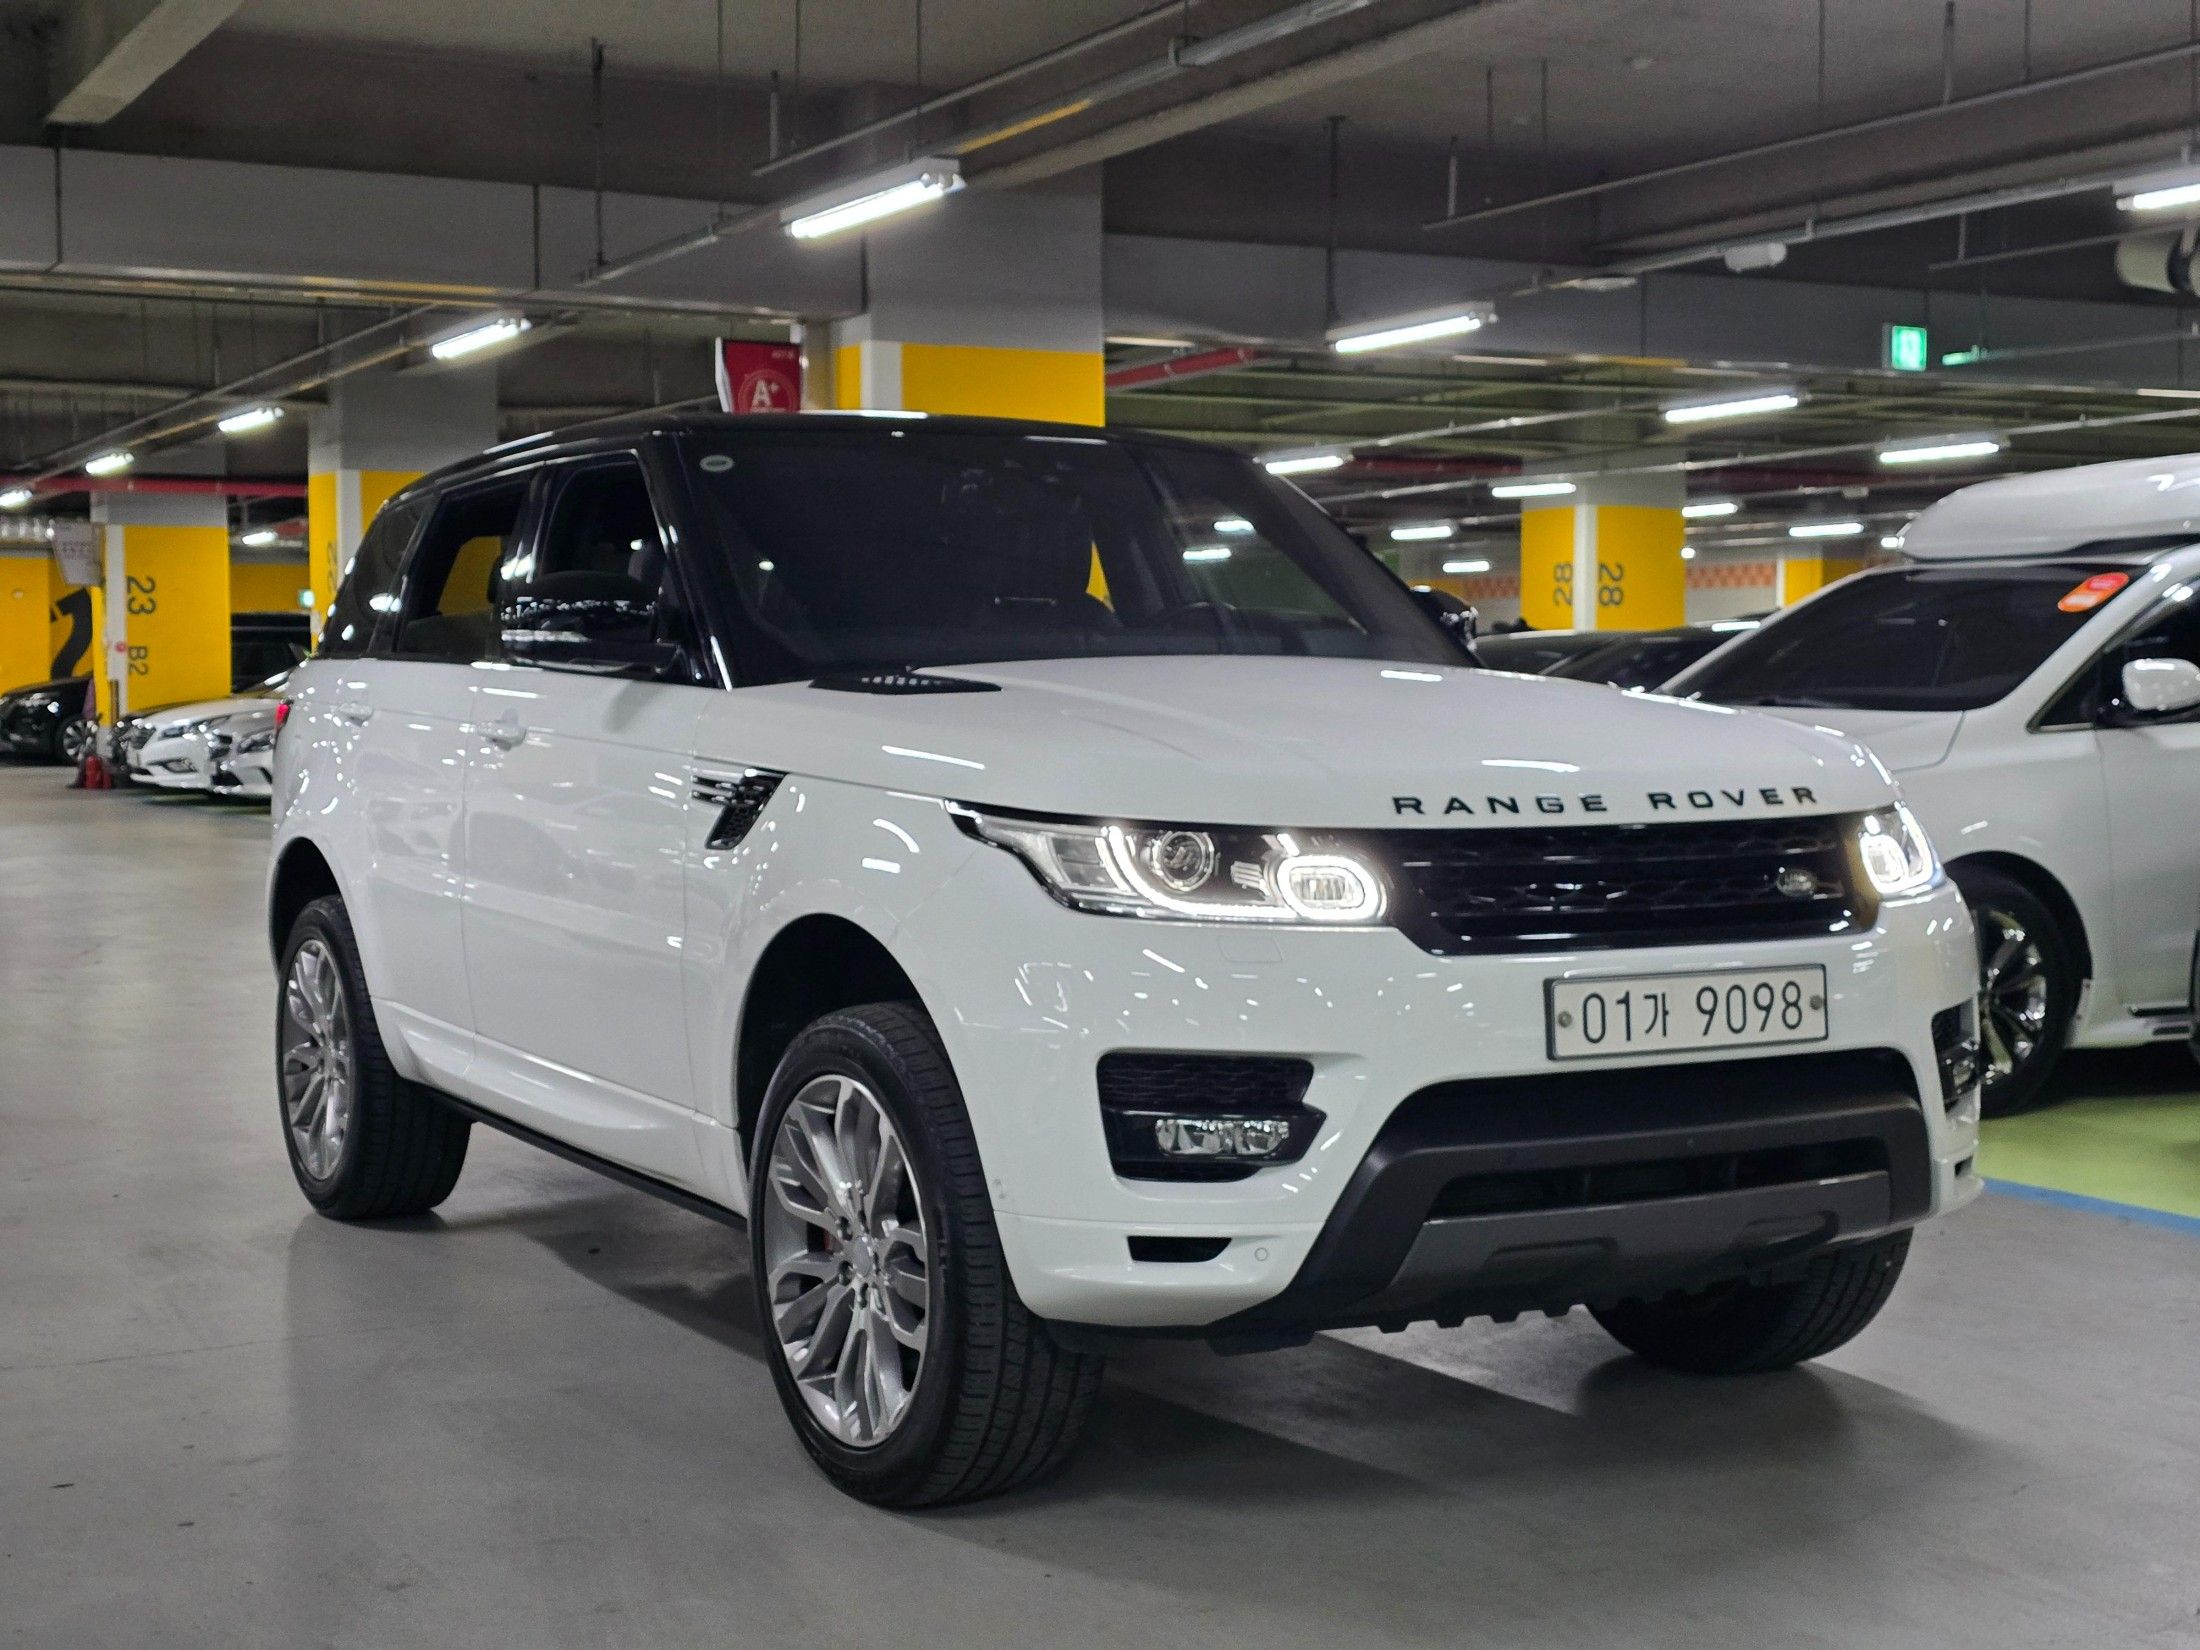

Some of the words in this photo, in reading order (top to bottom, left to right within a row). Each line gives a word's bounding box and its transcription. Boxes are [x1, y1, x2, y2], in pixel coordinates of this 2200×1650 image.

[127, 576, 156, 615] 23
[1552, 562, 1573, 607] 28
[1598, 563, 1624, 607] 28
[128, 646, 149, 676] B2
[1392, 794, 1608, 815] RANGE
[1647, 786, 1817, 809] ROVER
[1582, 990, 1669, 1044] 01가
[1696, 980, 1803, 1036] 9098
